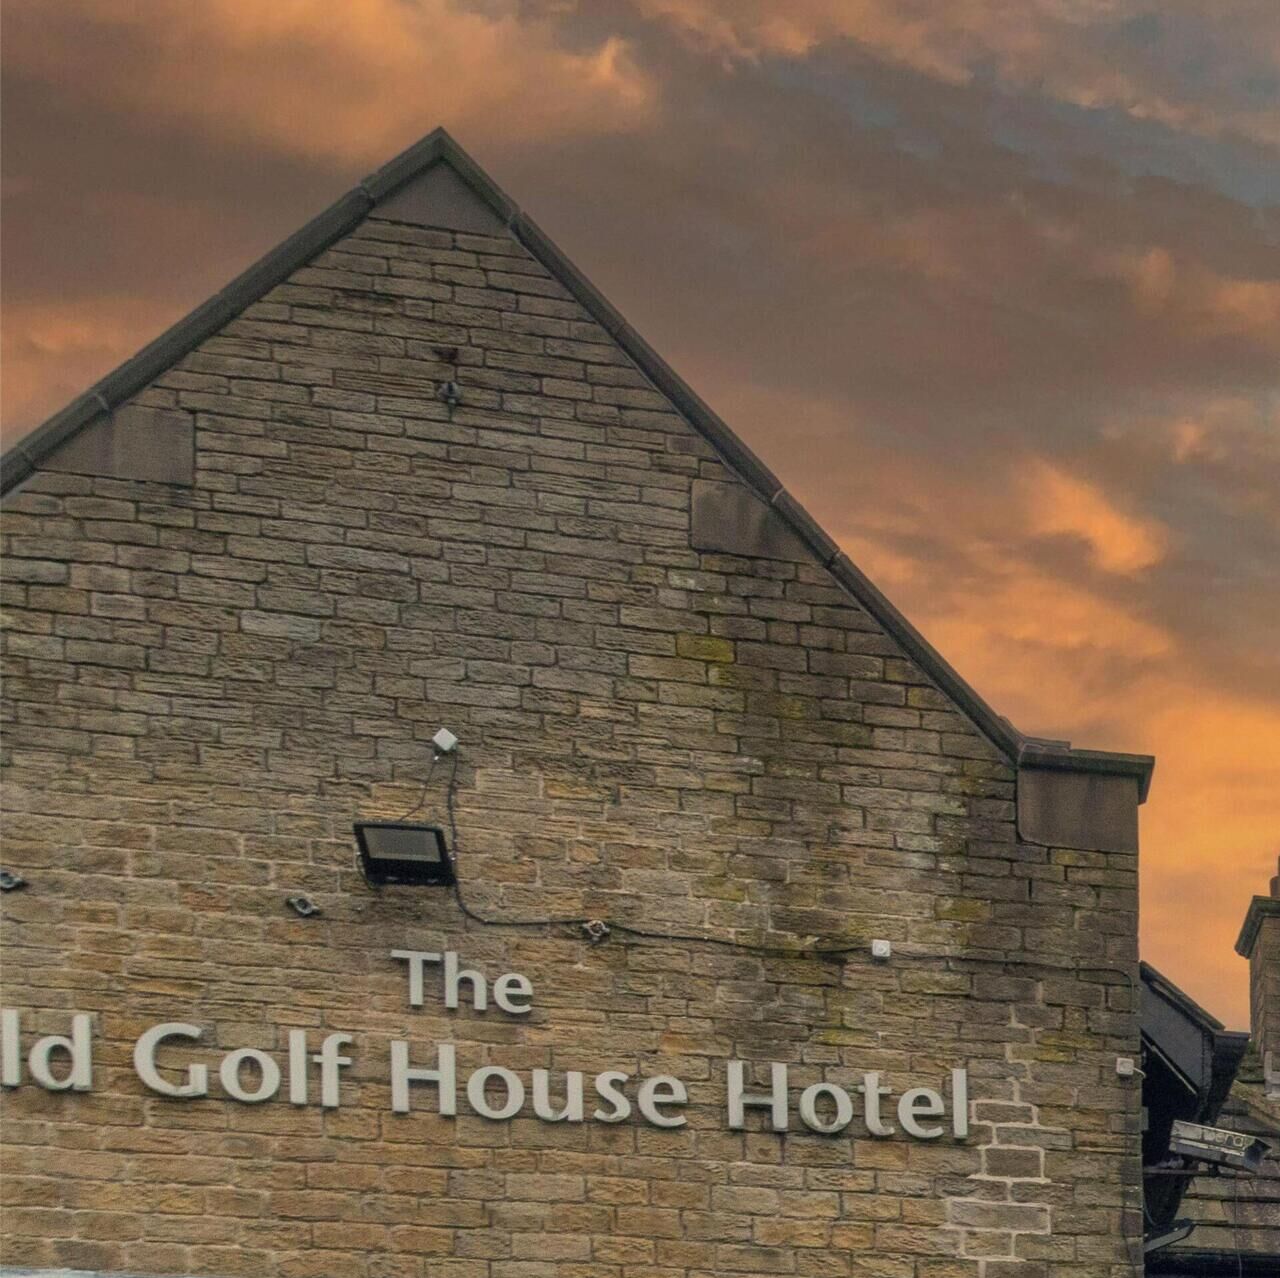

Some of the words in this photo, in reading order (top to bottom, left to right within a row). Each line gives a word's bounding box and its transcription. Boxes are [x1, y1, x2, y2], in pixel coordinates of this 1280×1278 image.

[391, 949, 534, 1014] The
[133, 1022, 353, 1108] Golf
[391, 1040, 688, 1128] House
[727, 1060, 969, 1140] Hotel
